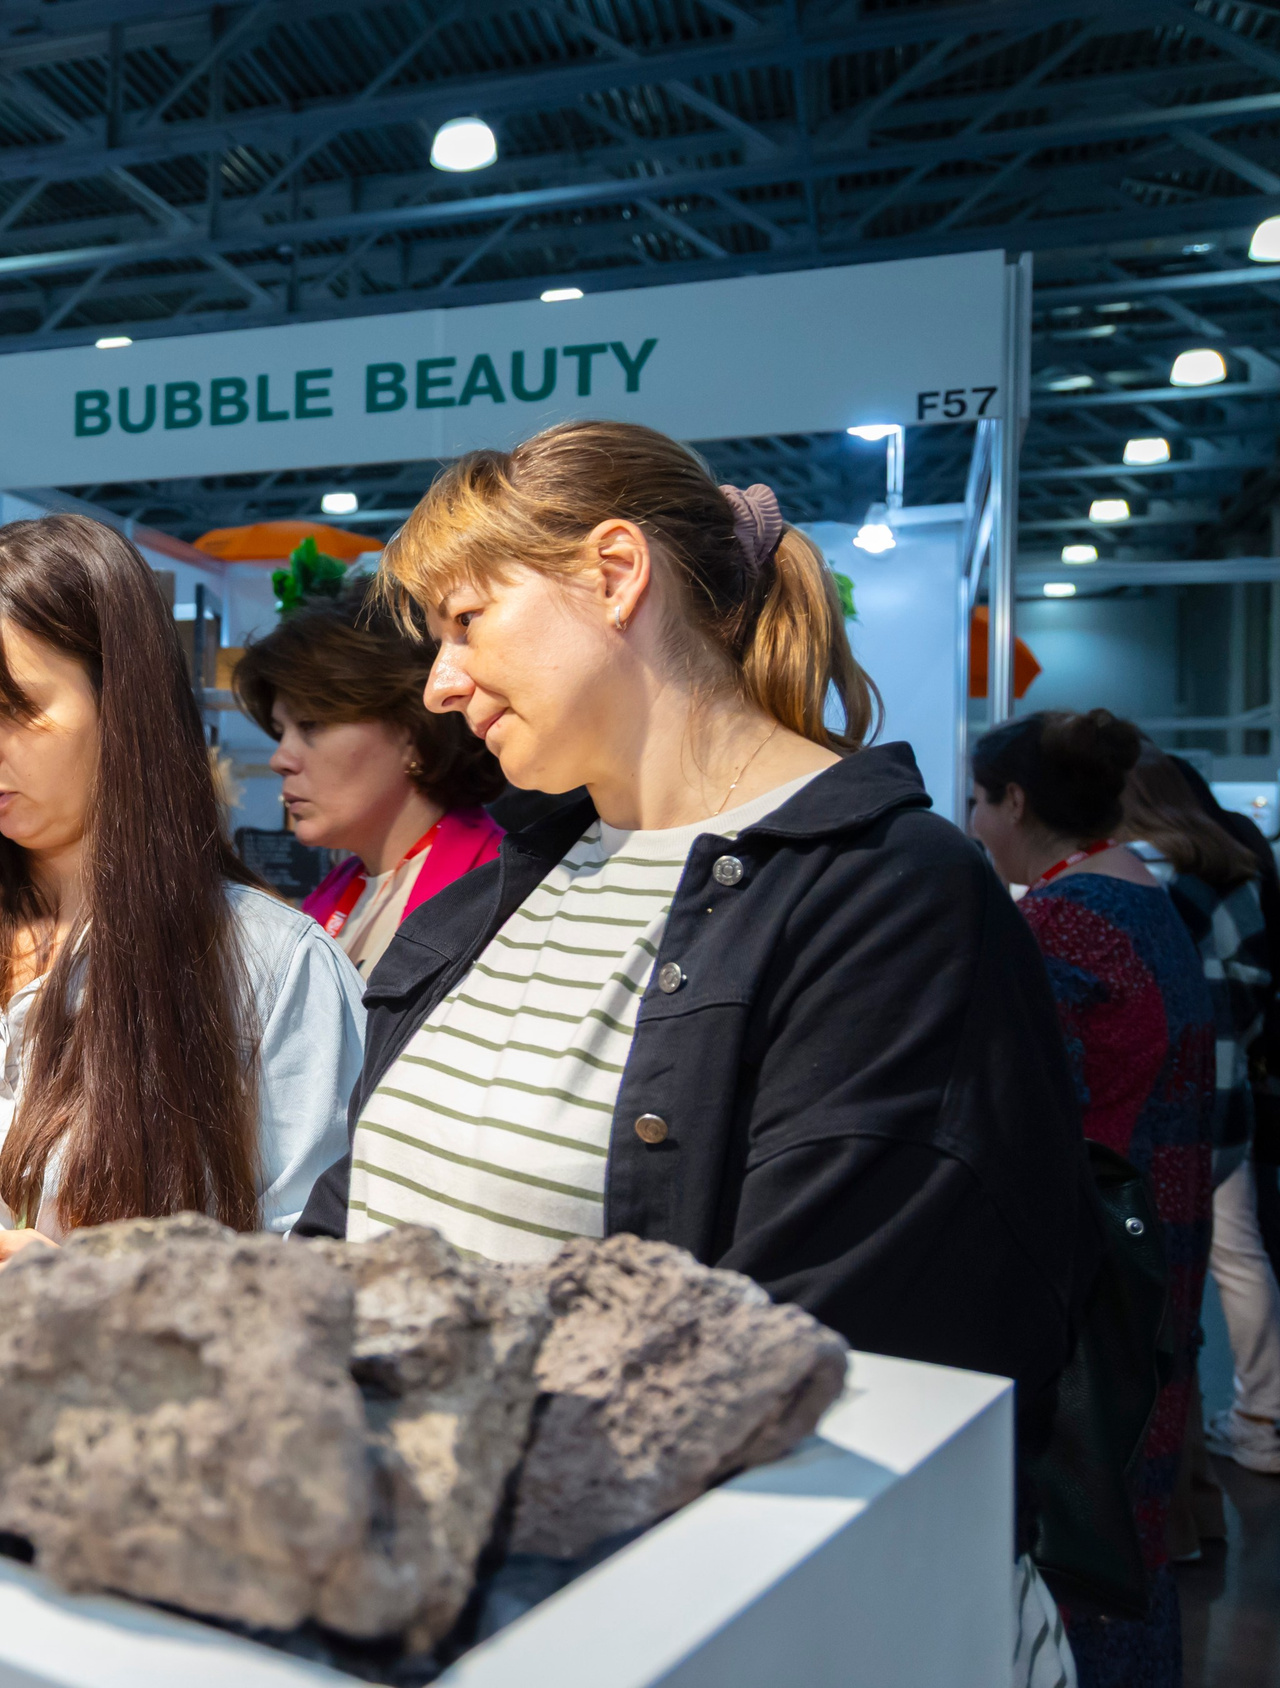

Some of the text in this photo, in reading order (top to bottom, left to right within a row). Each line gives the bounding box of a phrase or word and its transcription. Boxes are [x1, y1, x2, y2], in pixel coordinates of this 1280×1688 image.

[74, 337, 659, 437] BUBBLE BEAUTY
[917, 385, 999, 421] F57
